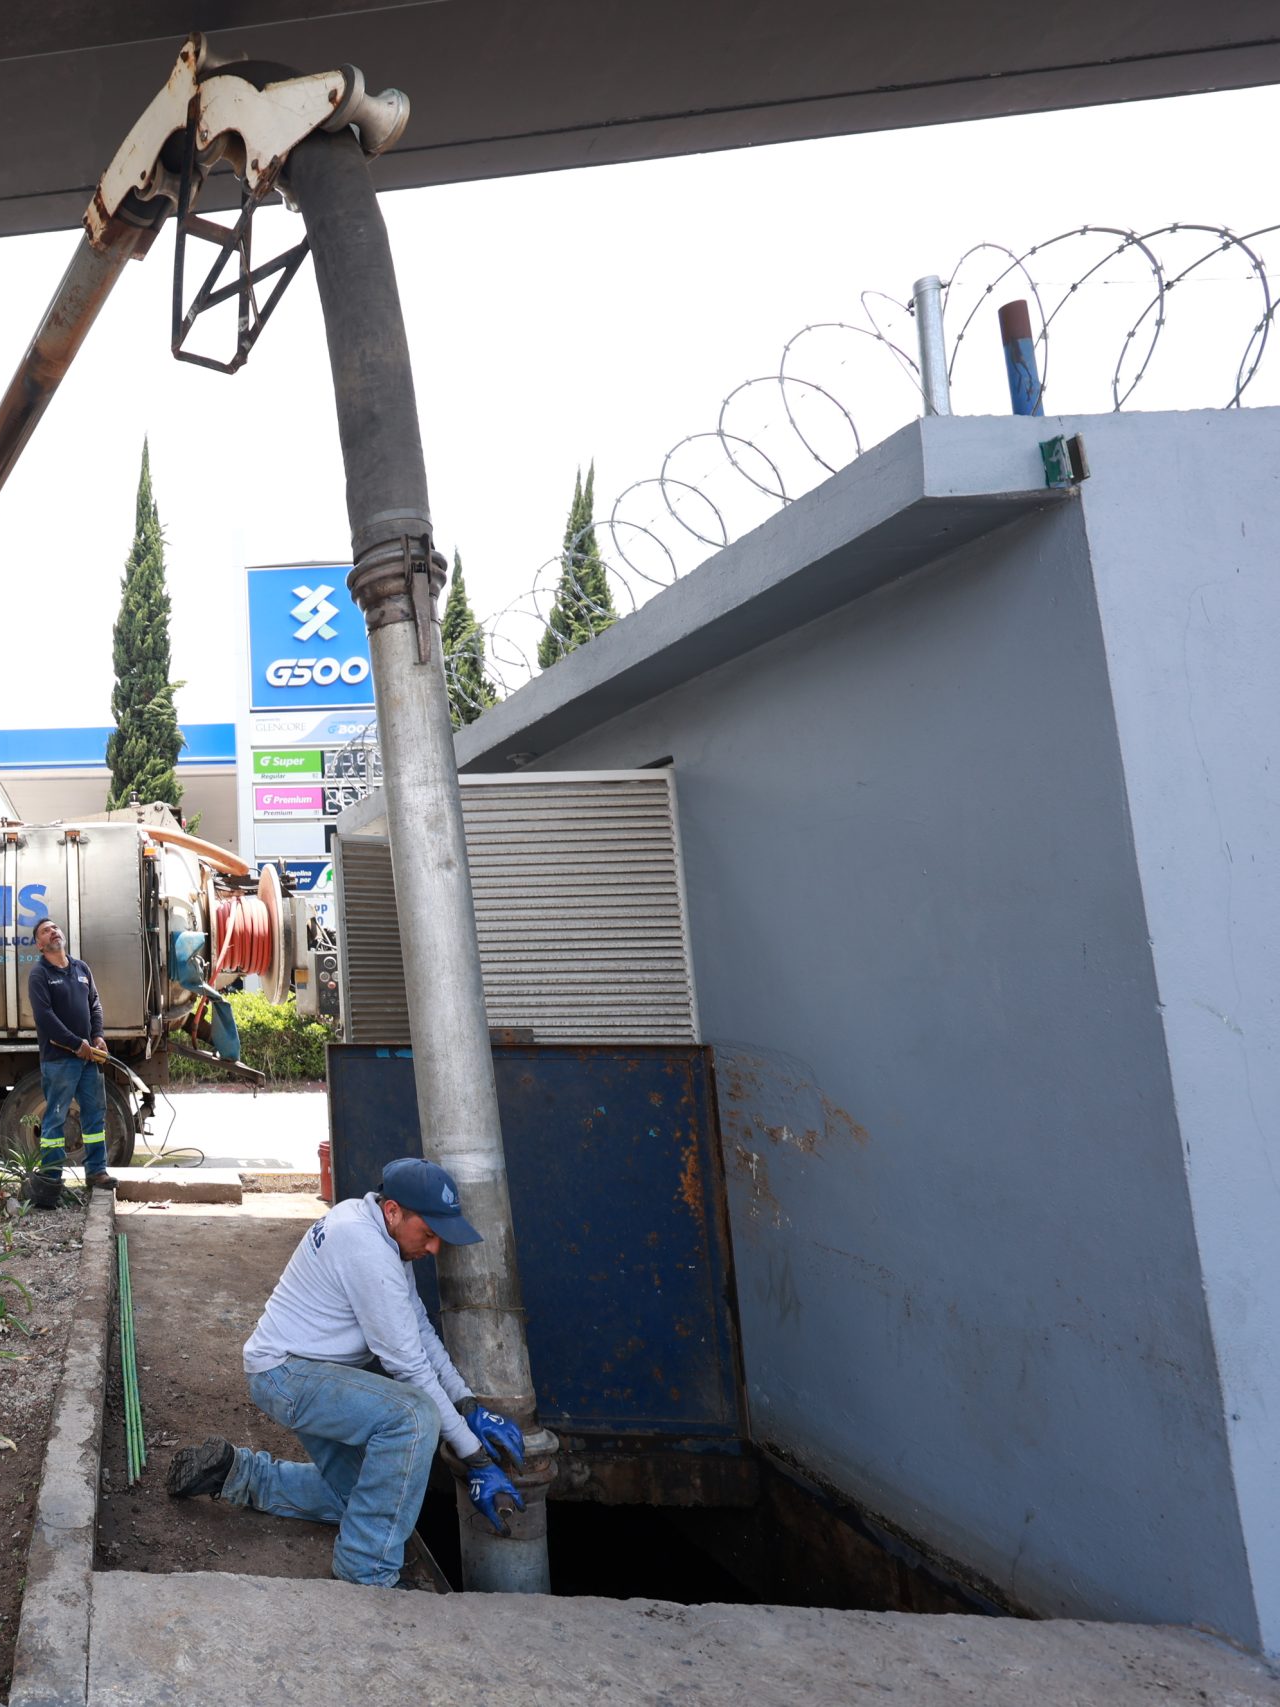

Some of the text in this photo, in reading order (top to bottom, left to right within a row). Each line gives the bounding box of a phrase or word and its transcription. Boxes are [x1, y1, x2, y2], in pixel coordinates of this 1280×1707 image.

[265, 656, 370, 688] G500
[273, 755, 305, 767] Super
[273, 795, 312, 804] Premium
